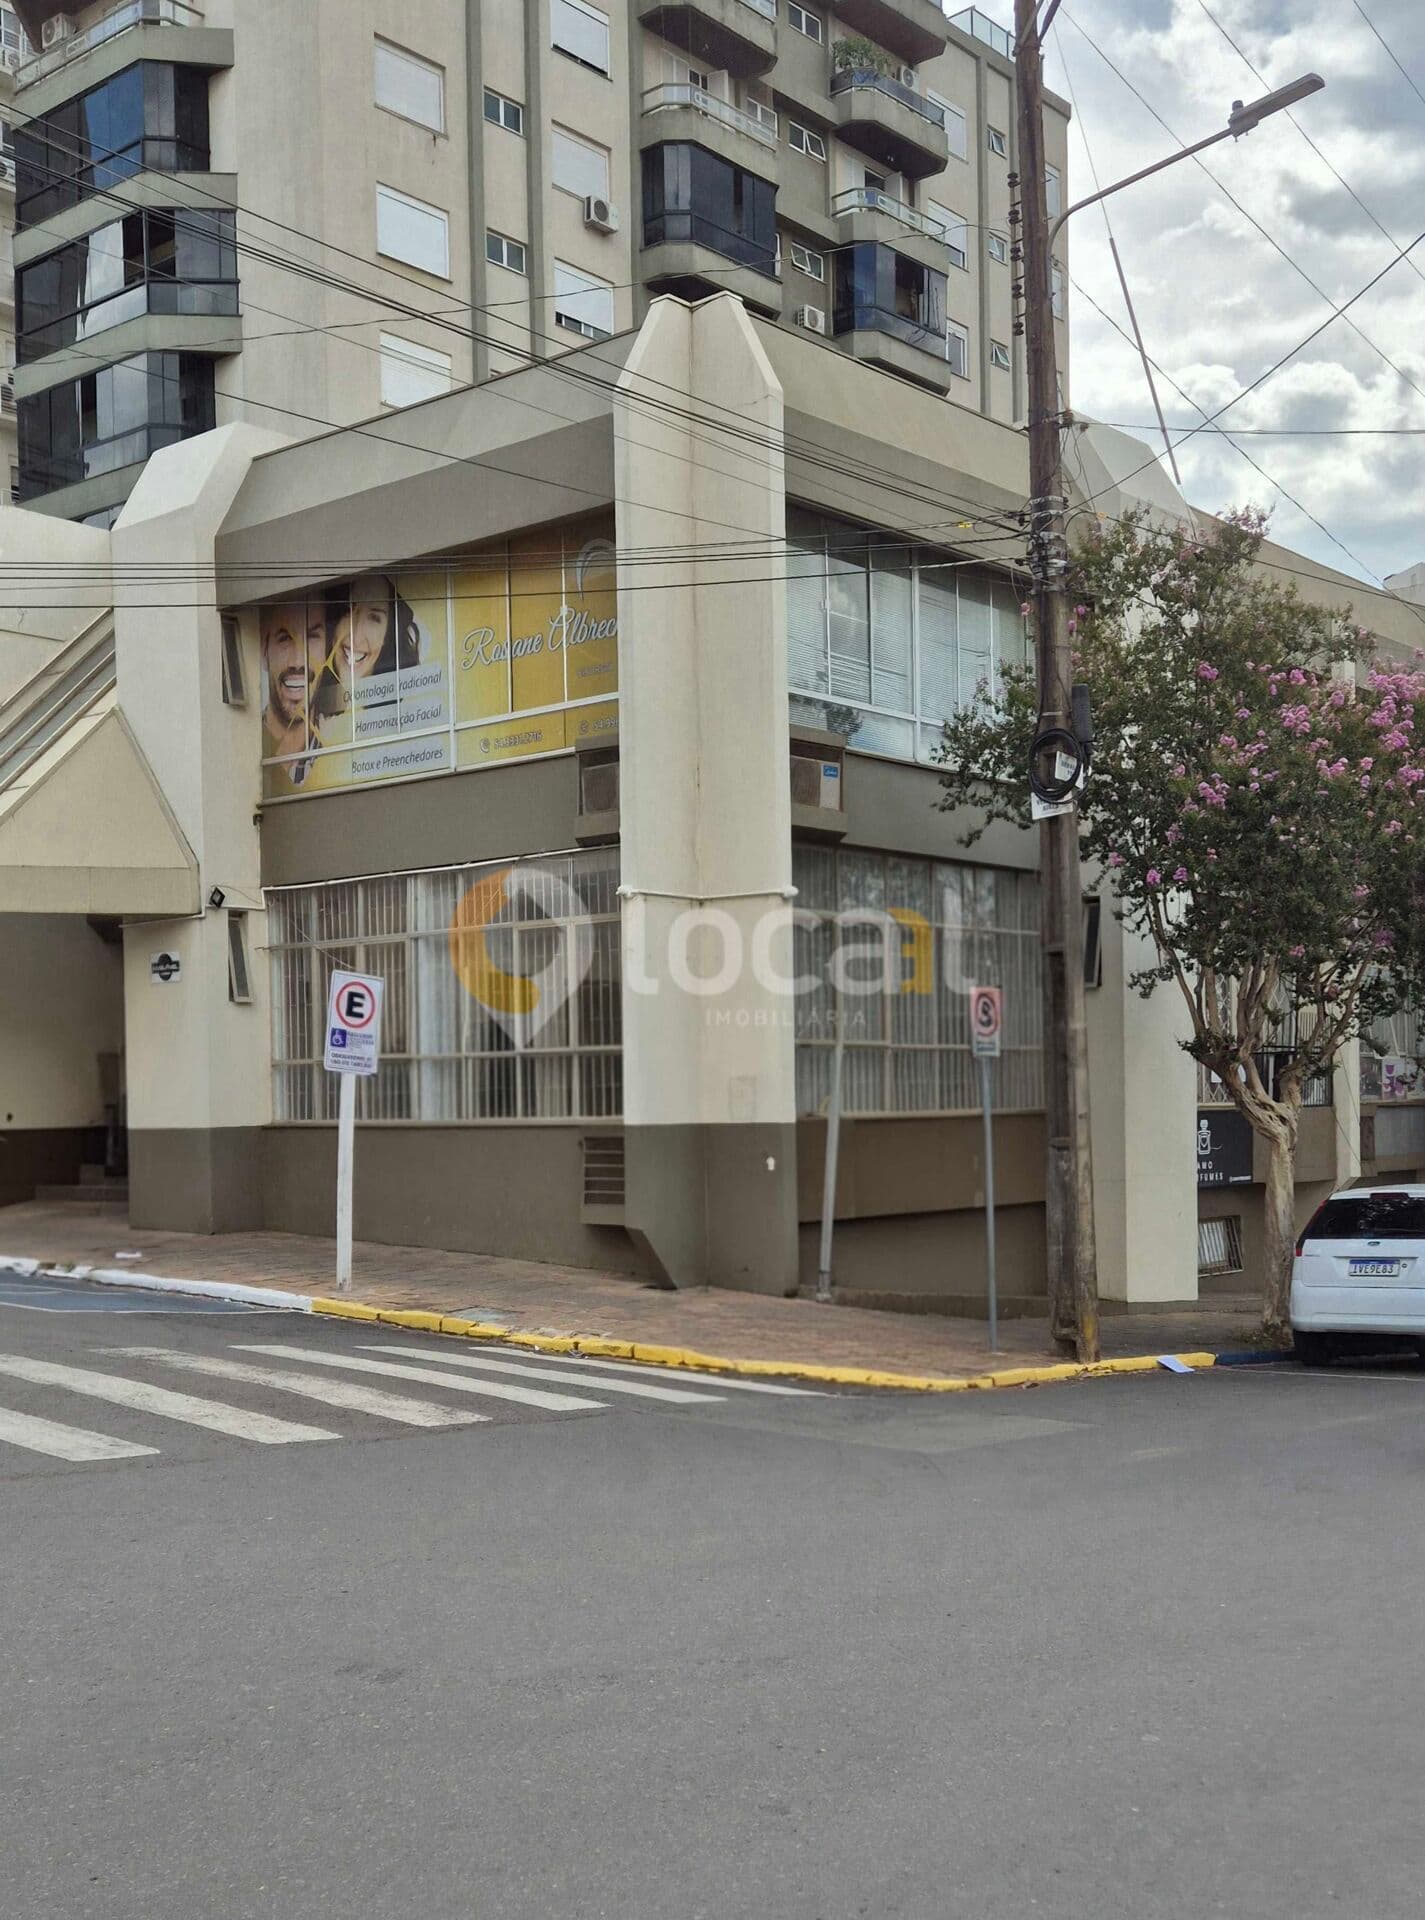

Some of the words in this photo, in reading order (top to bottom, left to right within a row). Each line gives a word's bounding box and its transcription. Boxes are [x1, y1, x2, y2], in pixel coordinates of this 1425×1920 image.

[396, 670, 442, 691] radicional
[416, 704, 441, 721] Facial
[352, 760, 374, 774] Botox
[376, 760, 381, 770] e
[382, 749, 443, 768] Preenchedores
[345, 990, 366, 1019] E
[1198, 1172, 1223, 1181] FUMES
